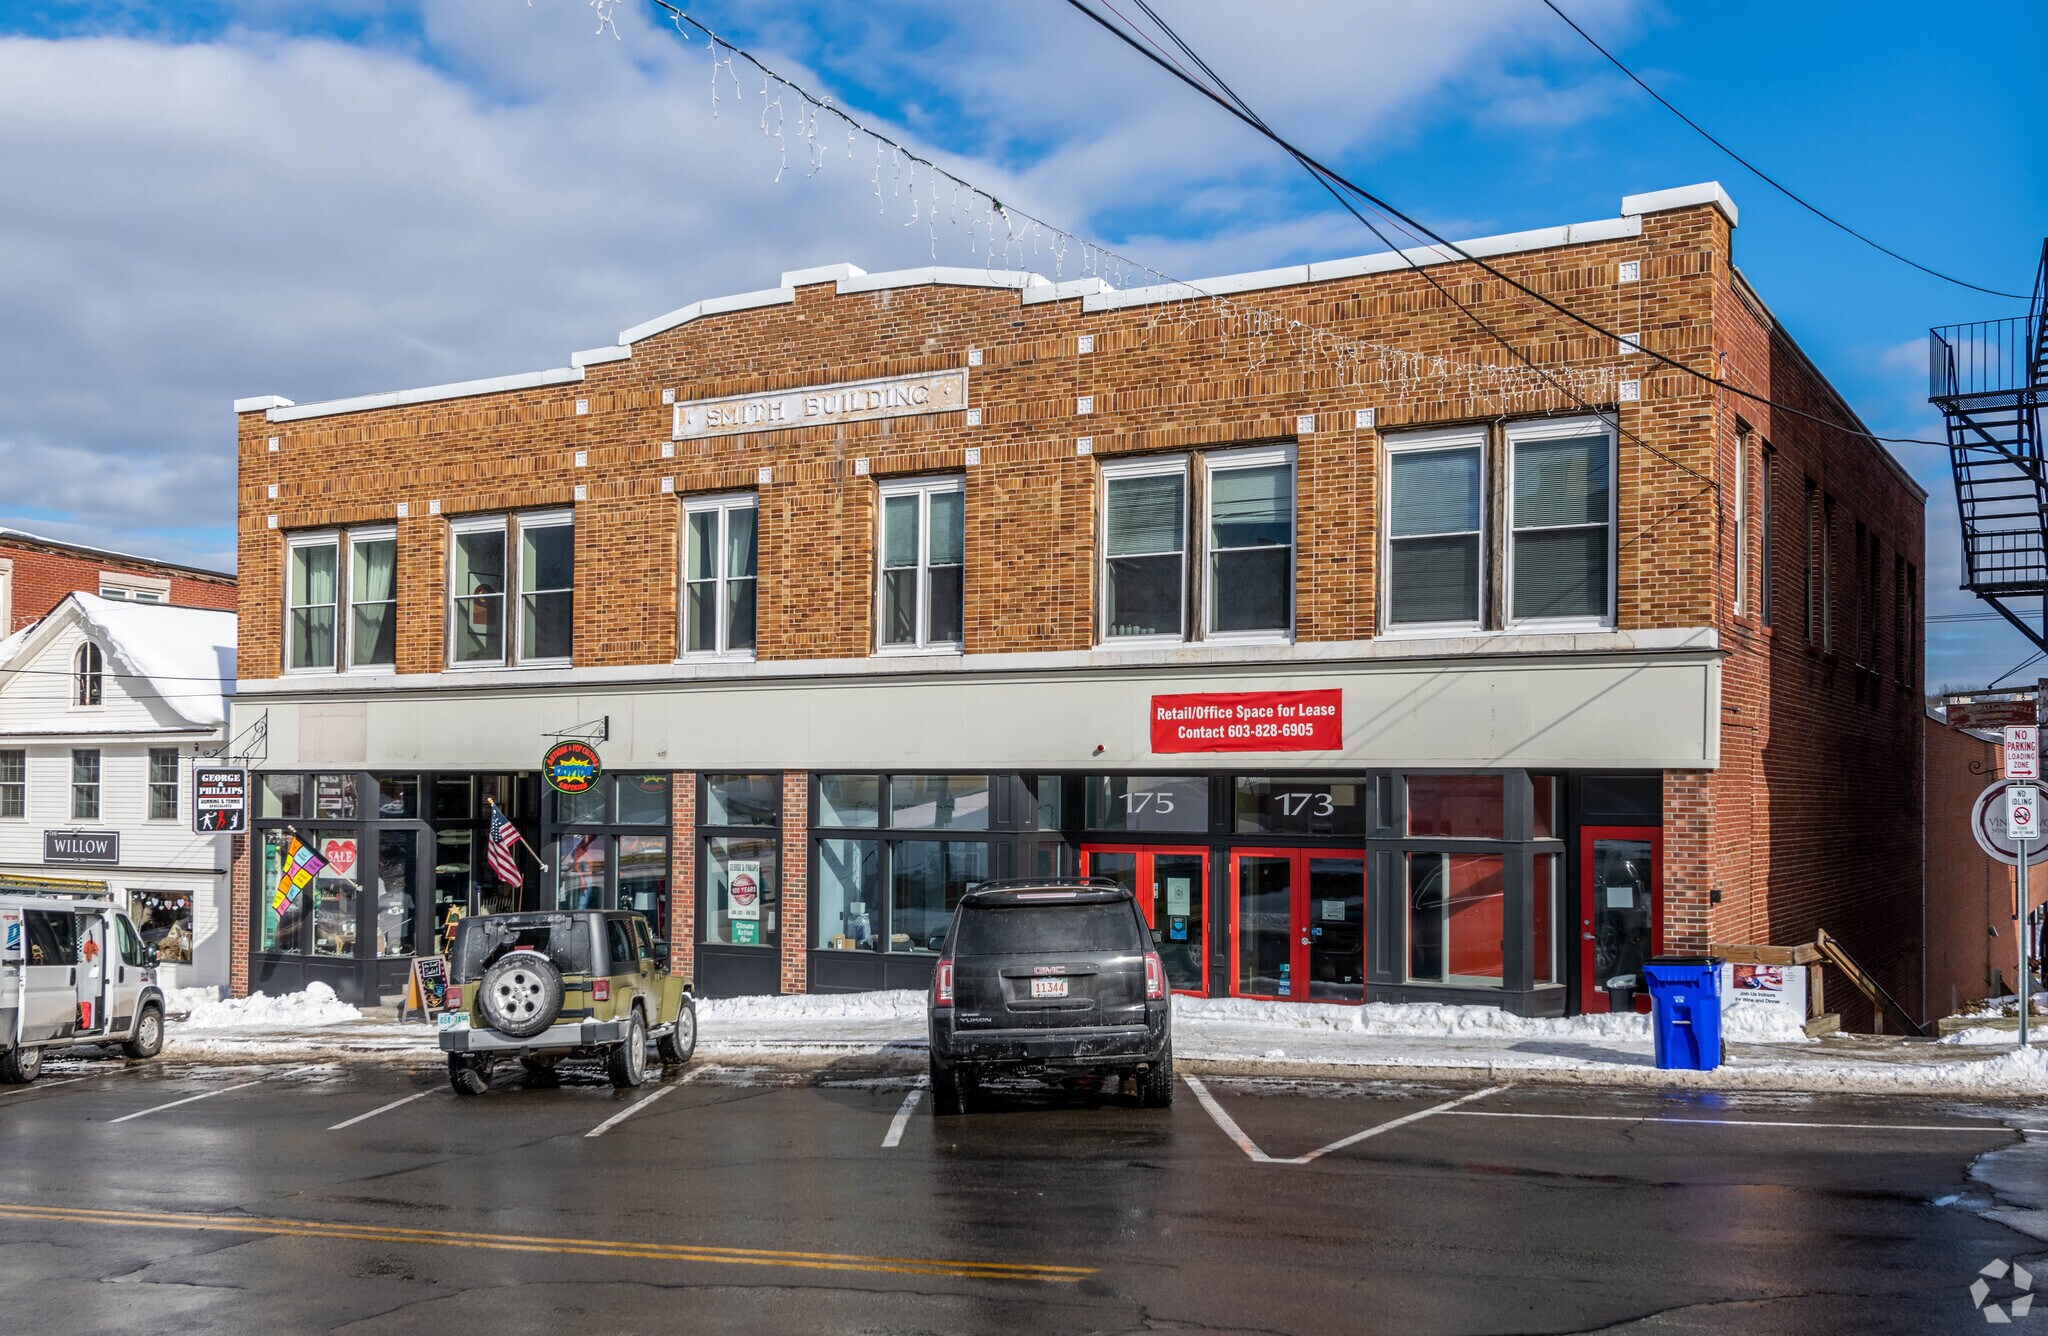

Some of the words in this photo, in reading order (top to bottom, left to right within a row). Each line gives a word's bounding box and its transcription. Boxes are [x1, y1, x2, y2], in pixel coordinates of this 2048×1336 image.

[706, 401, 785, 428] SMITH
[804, 385, 930, 418] BUILDING
[1157, 706, 1233, 720] Retail/Office
[1236, 705, 1274, 721] Space
[1277, 704, 1296, 717] for
[1298, 703, 1336, 717] Lease
[1178, 725, 1225, 739] Contact
[1227, 723, 1314, 738] 603-828-6905
[2015, 731, 2027, 740] NO
[2007, 742, 2036, 751] PARKING
[553, 765, 594, 777] KRYPTON
[202, 774, 241, 782] GEORGE
[199, 787, 243, 795] PHILLIPS
[1118, 792, 1175, 814] 175
[1274, 792, 1334, 817] 173
[1989, 817, 2007, 826] VIN
[54, 839, 108, 854] WILLOW
[328, 851, 353, 863] SALE
[736, 922, 755, 930] Climate
[740, 935, 751, 943] Now
[1033, 966, 1065, 974] GMC
[1035, 982, 1064, 993] 11344
